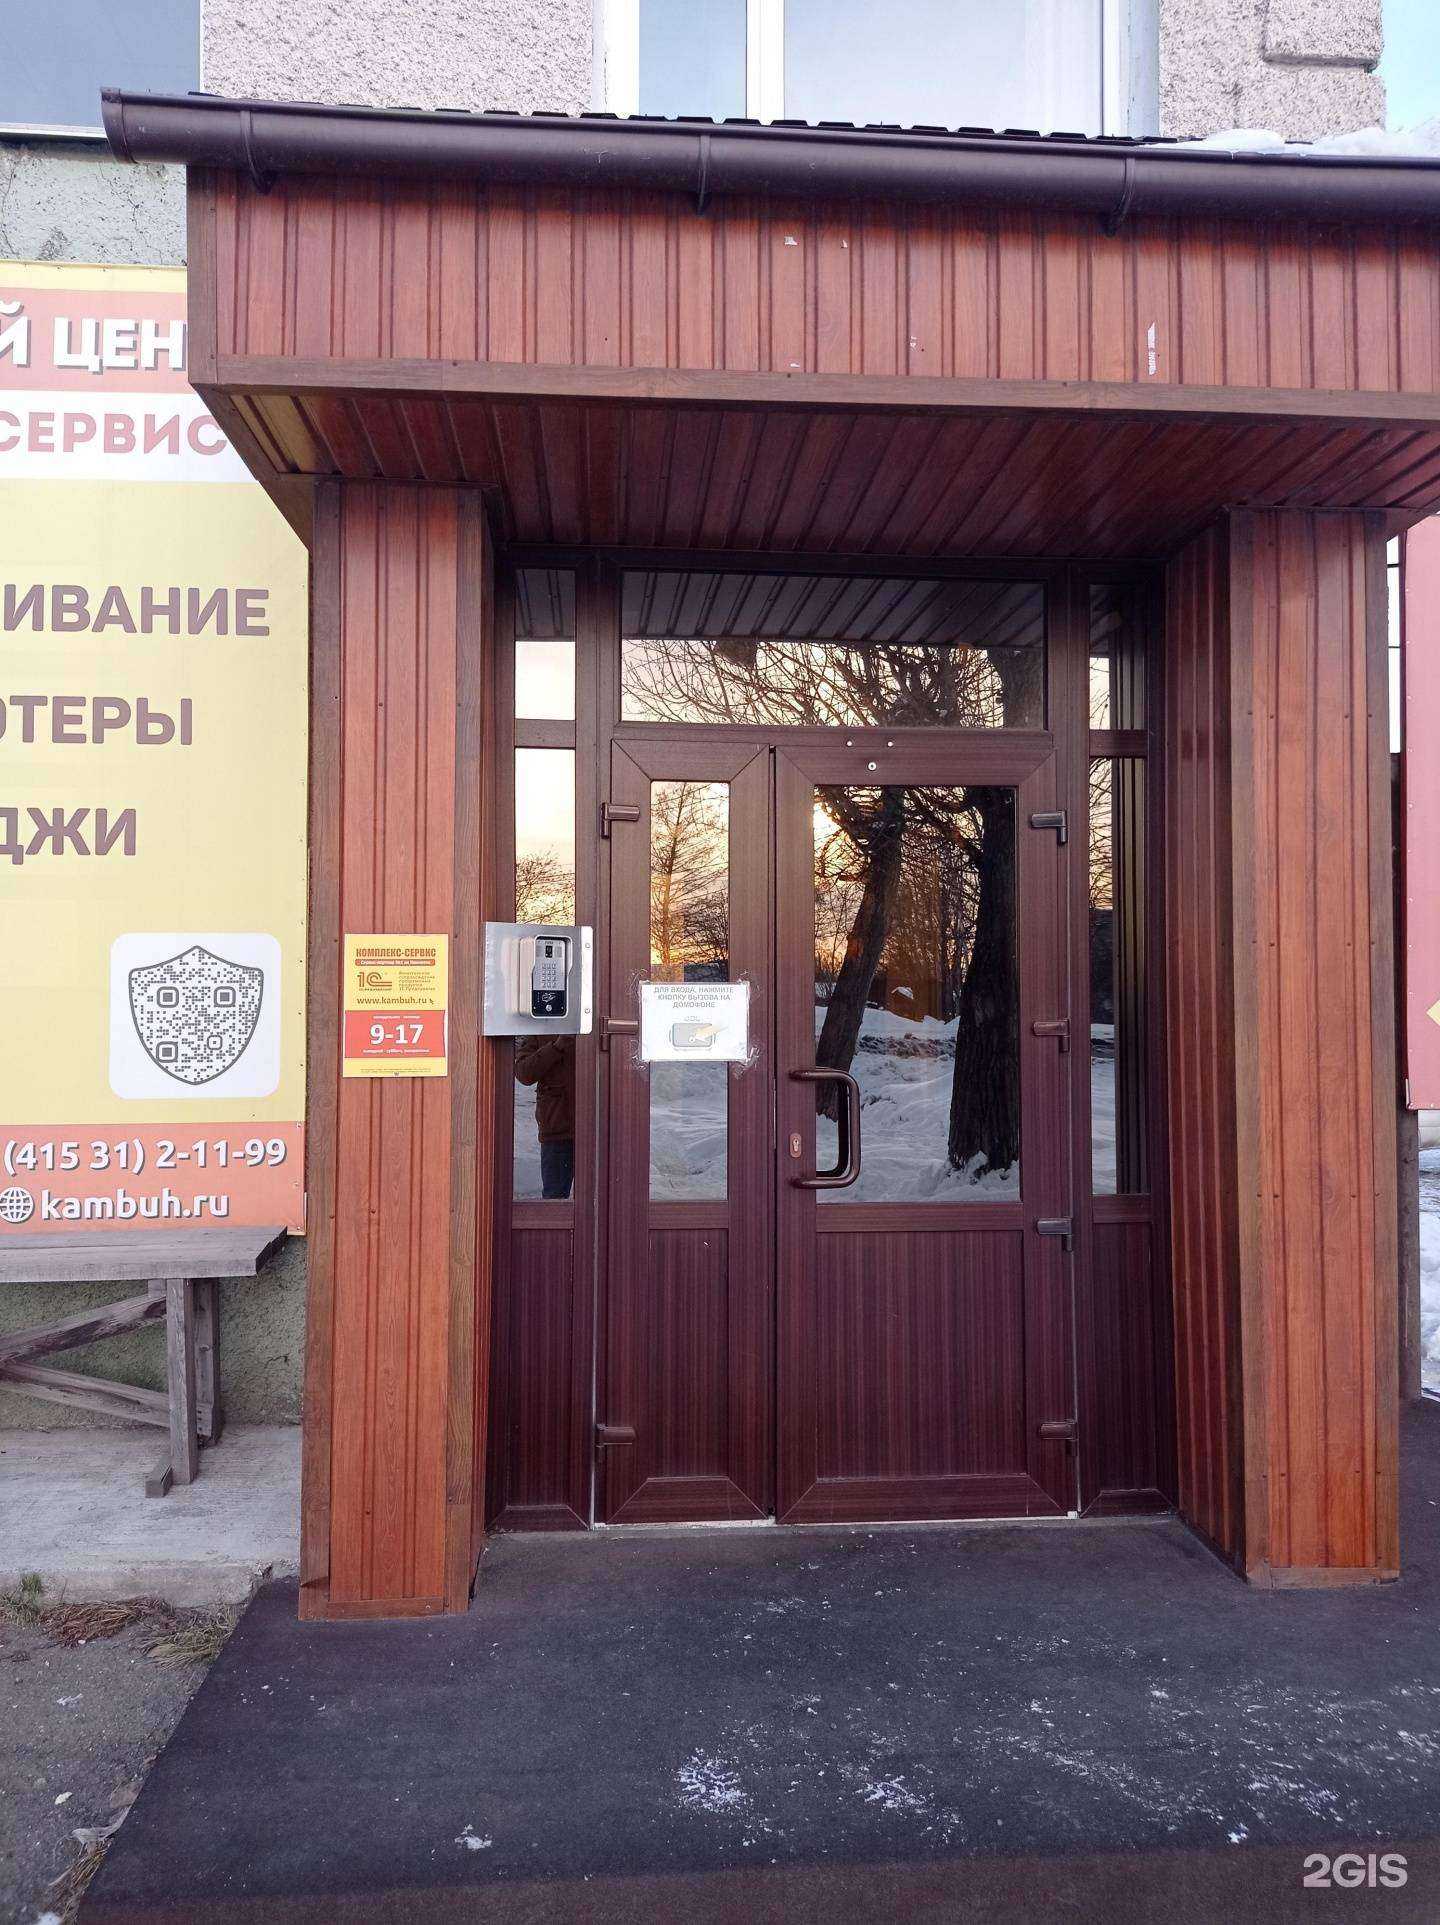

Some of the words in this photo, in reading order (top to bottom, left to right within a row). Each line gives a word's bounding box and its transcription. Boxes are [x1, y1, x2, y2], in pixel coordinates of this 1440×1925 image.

[53, 316, 188, 375] ЦЕН
[3, 583, 270, 636] ИВАНИЕ
[0, 695, 193, 745] ТЕРЫ
[356, 948, 437, 958] КОМПЛЕКС-СЕРВИС
[356, 996, 428, 1005] www.kambuh.ru
[658, 994, 687, 1002] КНОПКУ
[687, 994, 719, 1002] ВЫЗОВА
[699, 986, 734, 994] НАЖМИТЕ
[672, 1001, 716, 1009] ДОМОФОНЕ
[370, 1023, 424, 1046] 9-17
[3, 1138, 80, 1177] (415
[89, 1138, 145, 1175] 31)
[155, 1138, 286, 1169] 2-11-99
[40, 1188, 229, 1221] kambuh.ru
